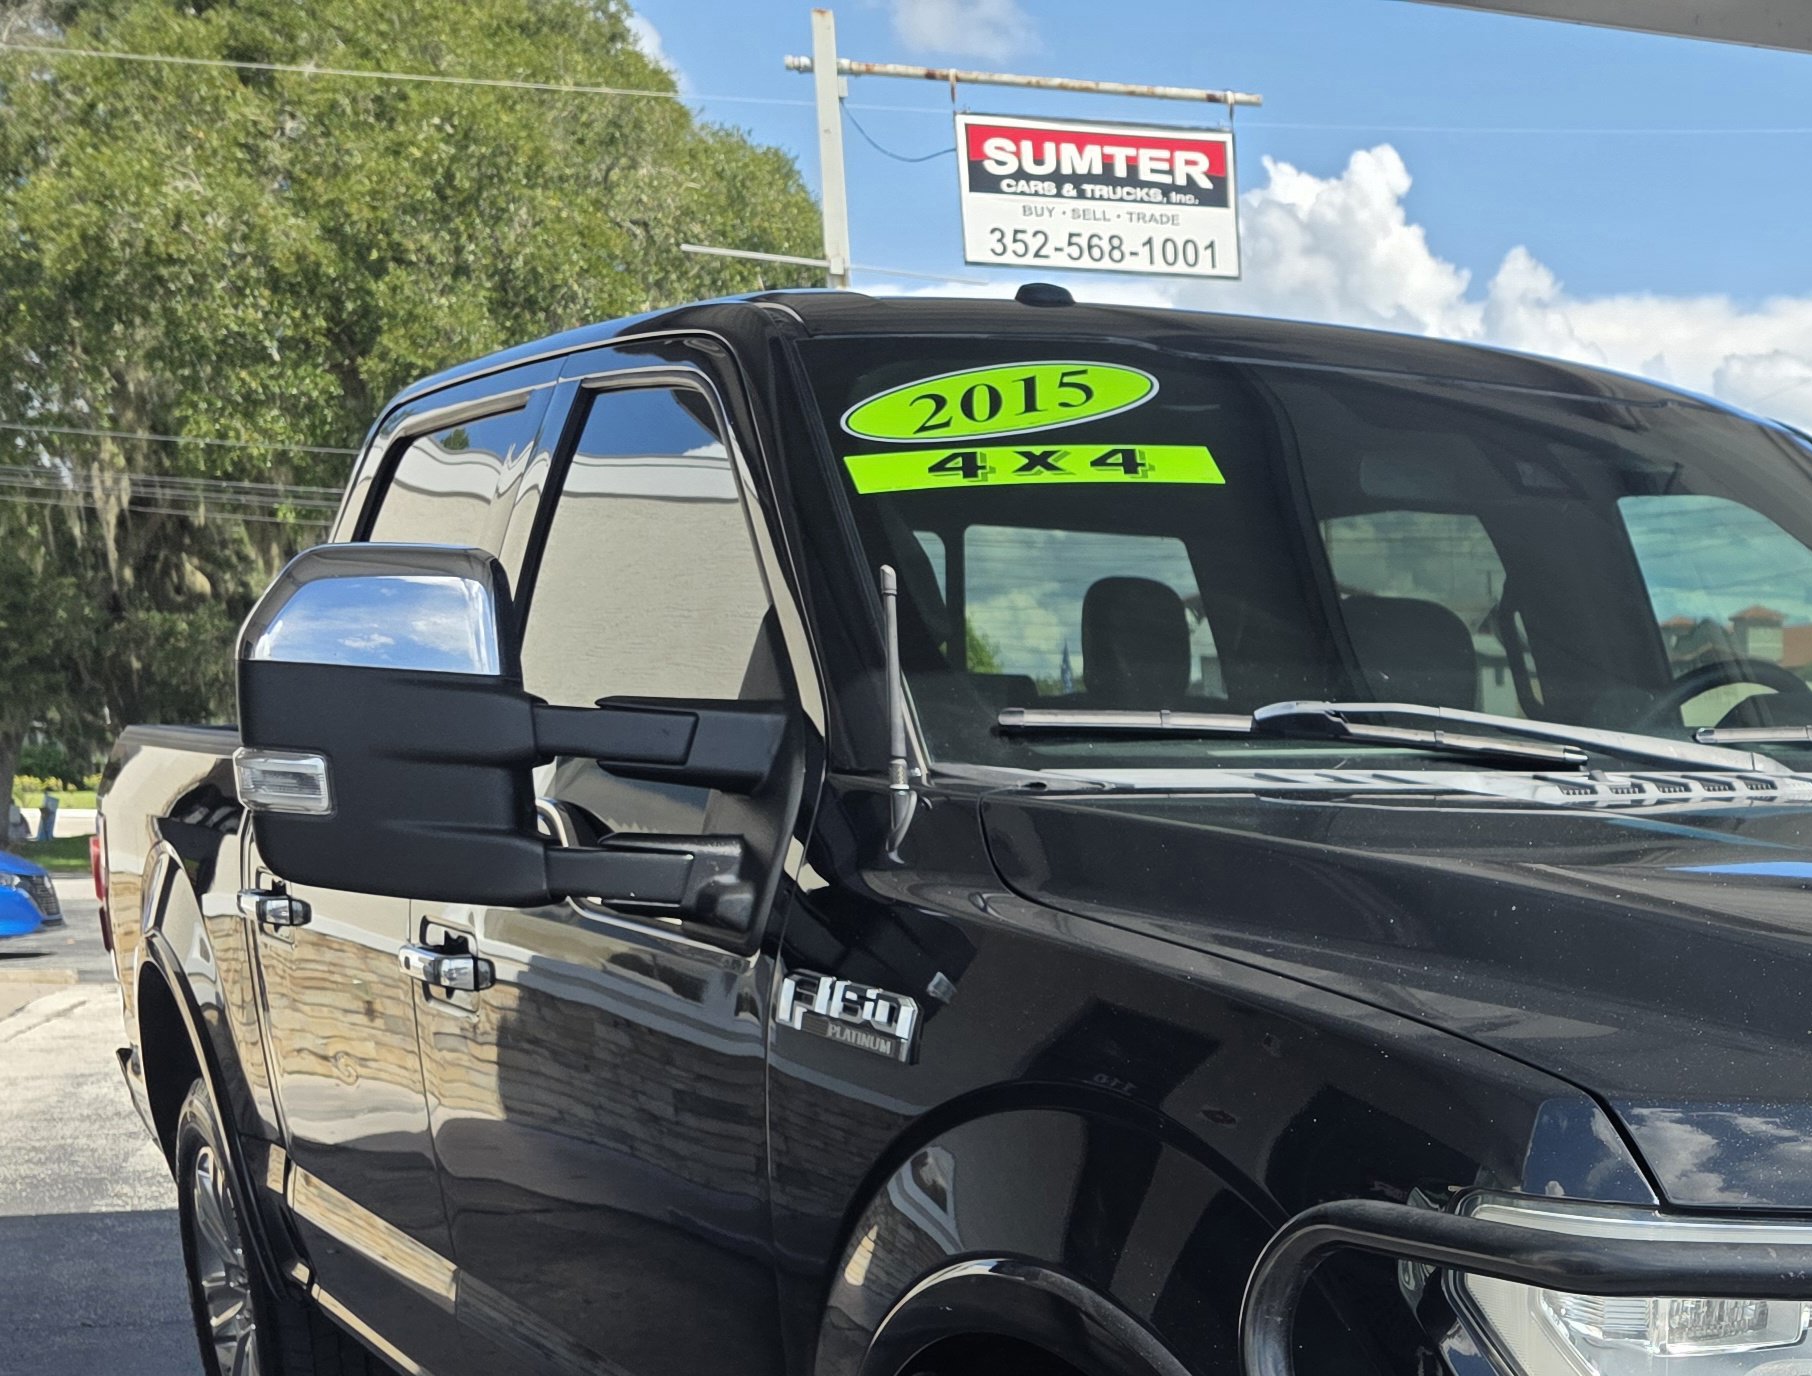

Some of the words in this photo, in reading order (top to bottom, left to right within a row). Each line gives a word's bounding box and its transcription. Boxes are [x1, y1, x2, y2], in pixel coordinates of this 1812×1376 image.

[982, 137, 1214, 189] SUMTER
[1000, 178, 1057, 195] CARS
[1060, 182, 1078, 197] &
[1082, 184, 1168, 204] TRUCKS,
[1022, 204, 1055, 218] BUY
[1071, 208, 1111, 223] SELL
[1127, 211, 1180, 226] TRADE
[989, 227, 1218, 269] 352-568-1001
[909, 369, 1095, 434] 2015
[927, 451, 996, 481] 4
[1089, 448, 1156, 479] 4
[826, 1023, 893, 1056] PLATINUM
